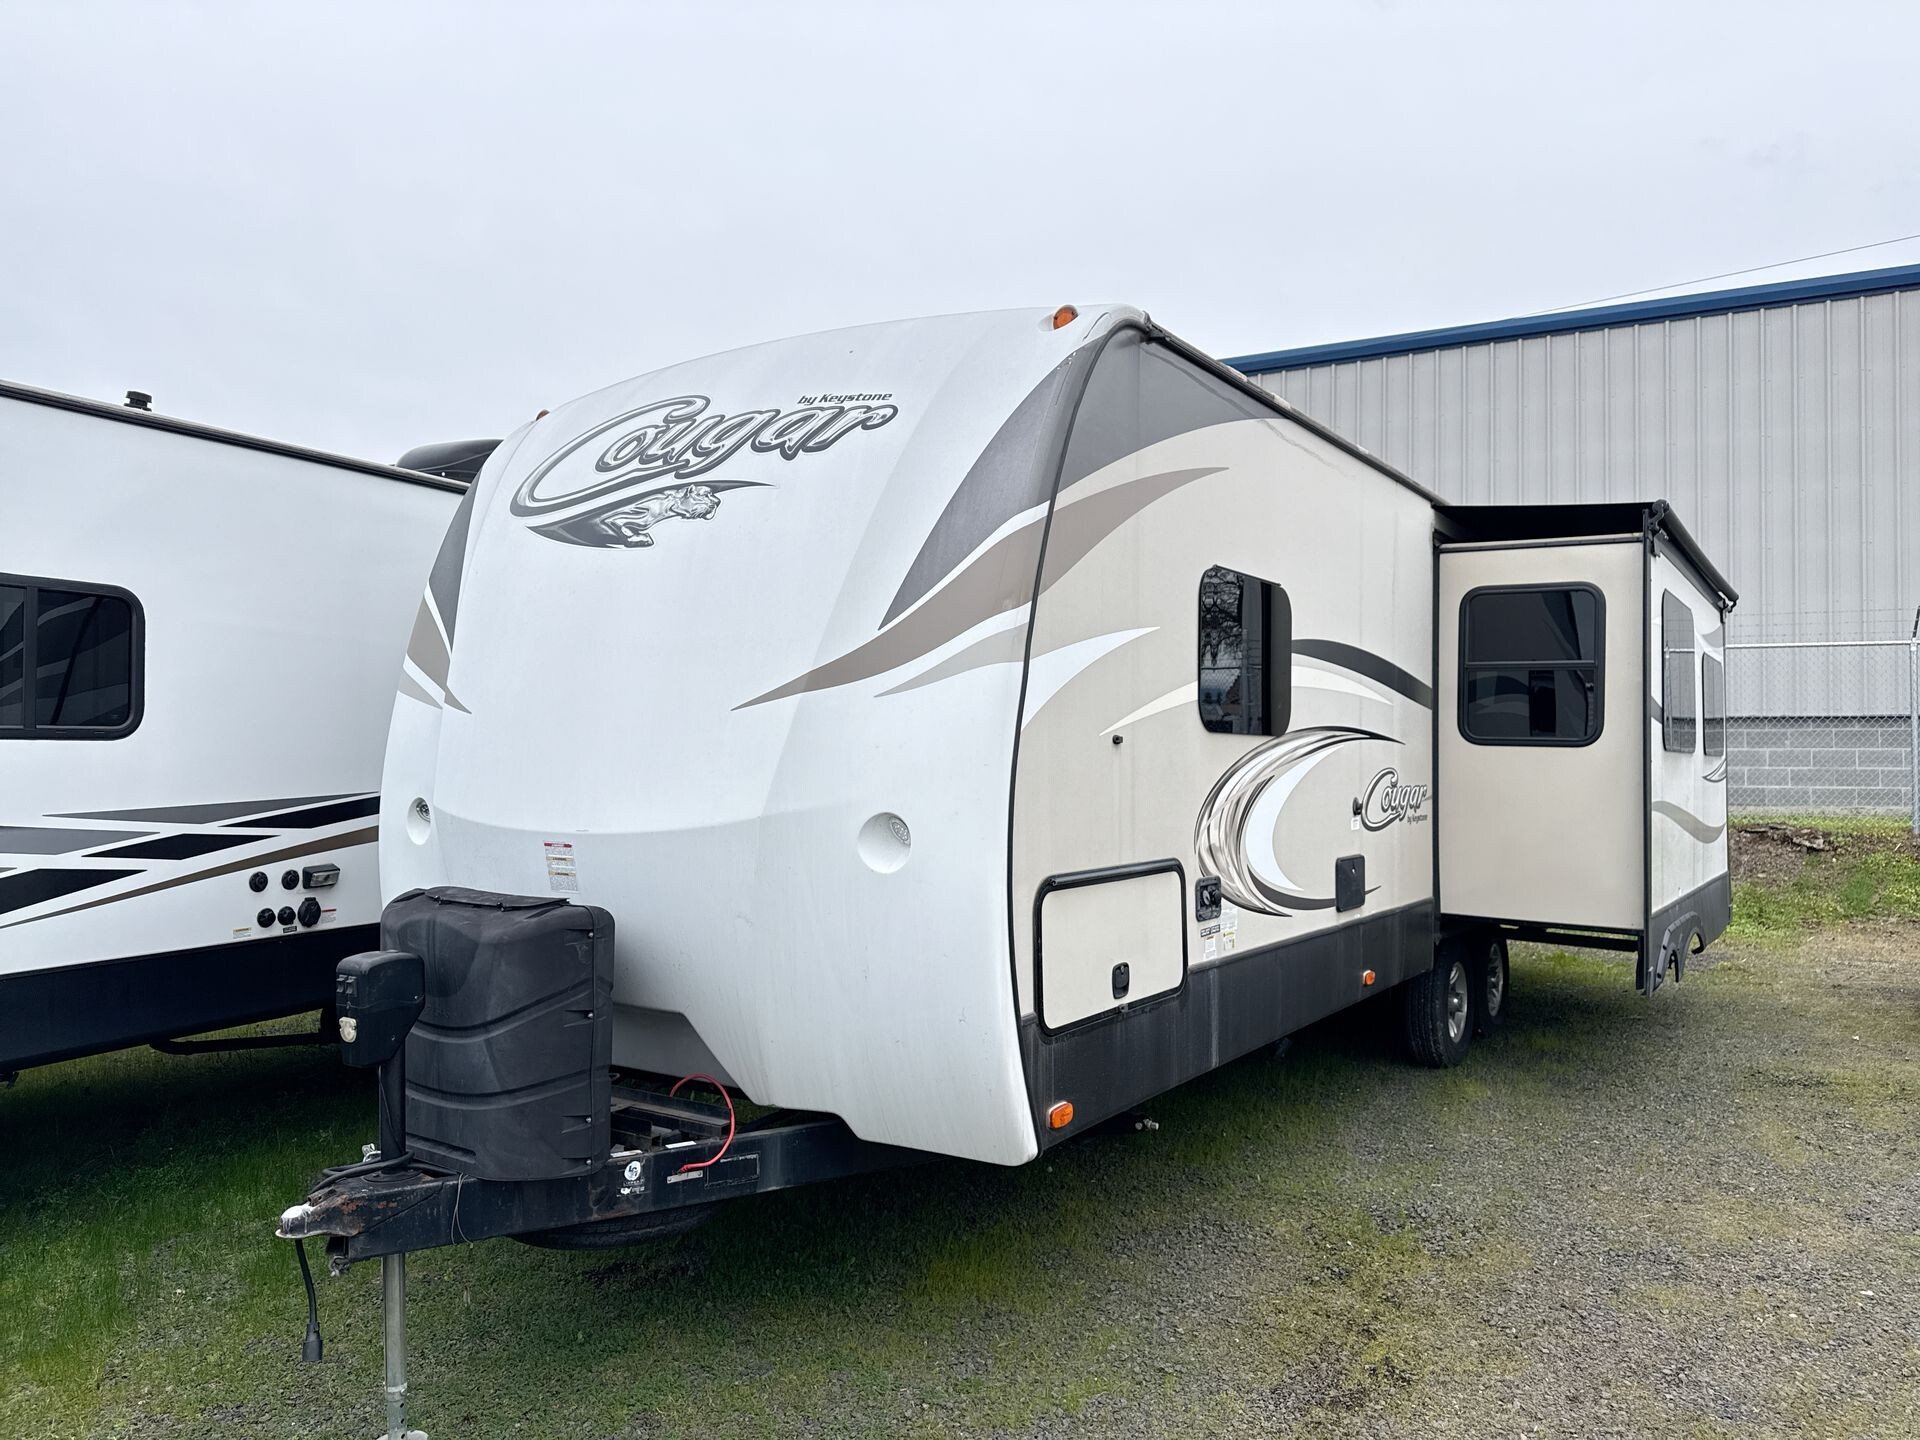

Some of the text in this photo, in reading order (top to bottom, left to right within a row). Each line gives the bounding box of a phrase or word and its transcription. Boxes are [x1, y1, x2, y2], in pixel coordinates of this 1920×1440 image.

[797, 393, 893, 406] by Keystone
[510, 394, 899, 518] Cougar
[1361, 767, 1427, 832] Cougar
